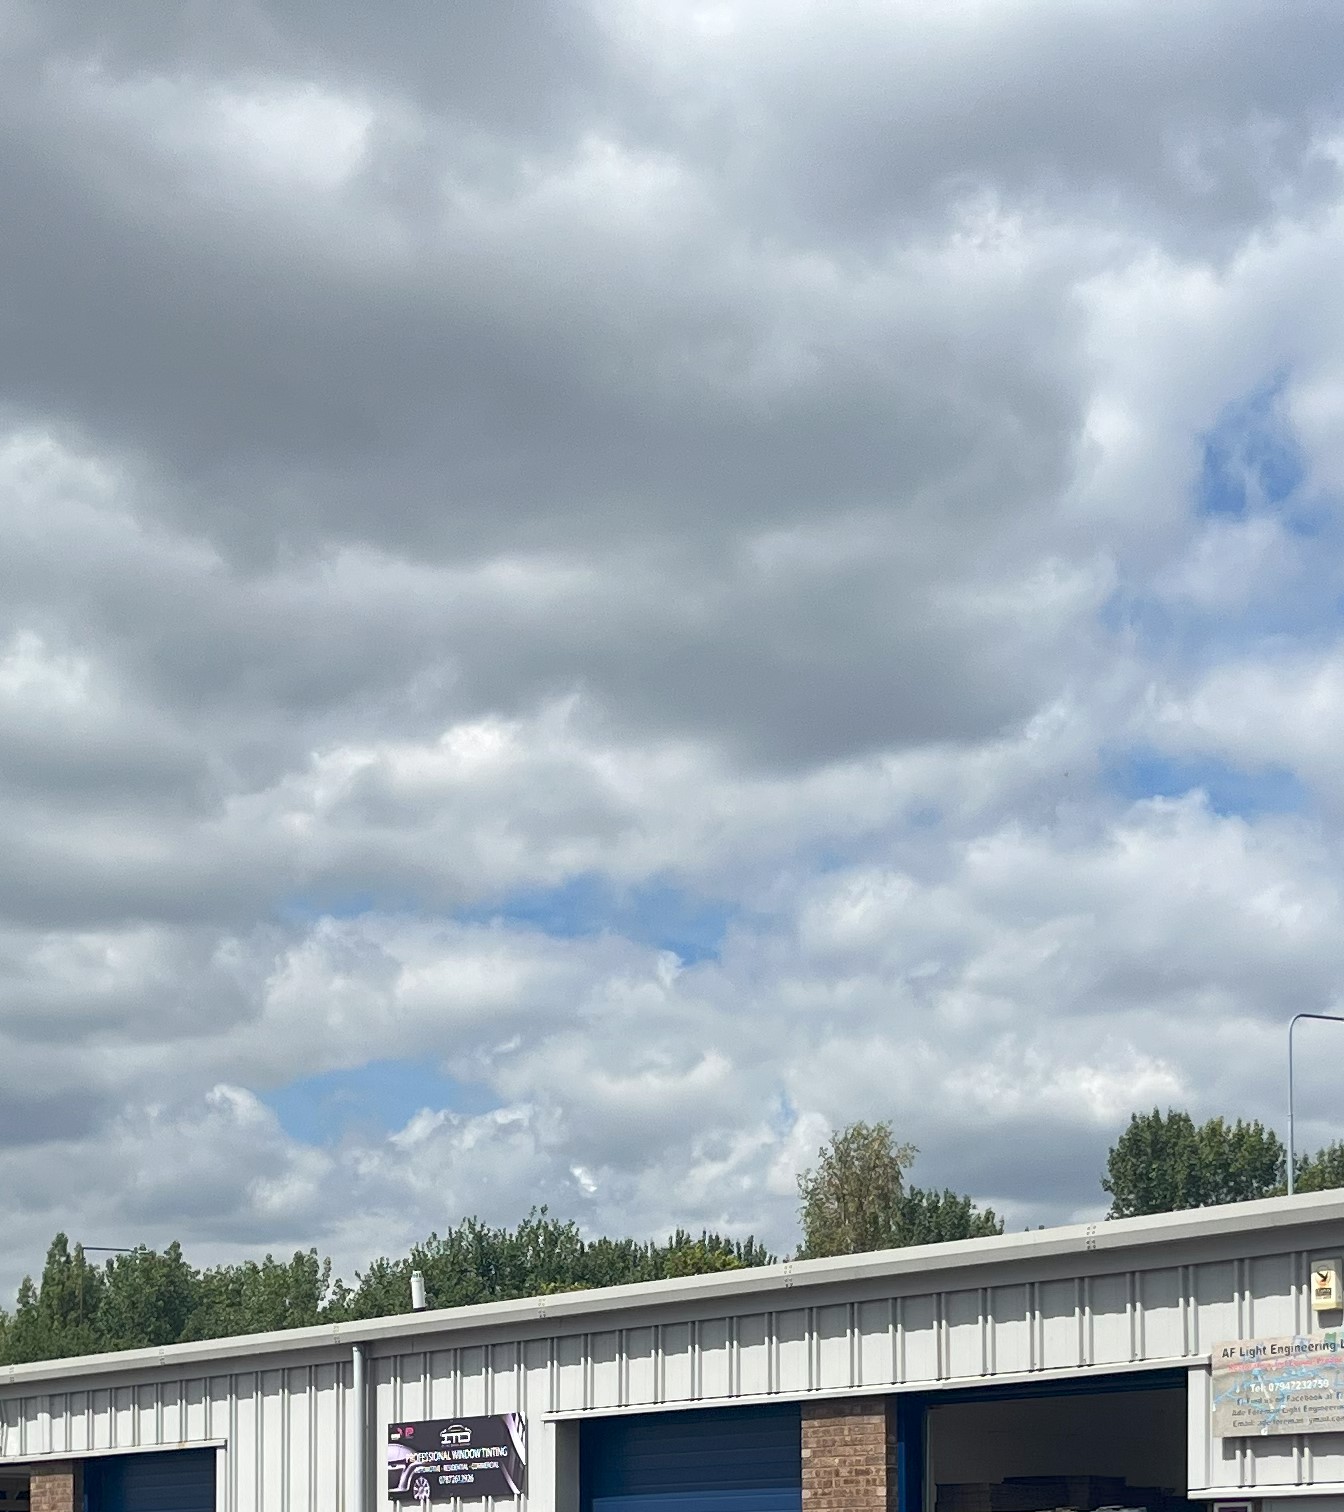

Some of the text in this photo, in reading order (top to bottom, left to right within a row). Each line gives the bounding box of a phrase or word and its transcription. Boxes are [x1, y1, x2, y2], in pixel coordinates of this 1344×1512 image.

[1222, 1348, 1235, 1358] AF
[1240, 1346, 1266, 1358] Light
[1271, 1342, 1336, 1356] Engineering
[1286, 1394, 1323, 1402] Facebook
[406, 1446, 508, 1463] PROFESSIONAL WINDOW TINTING
